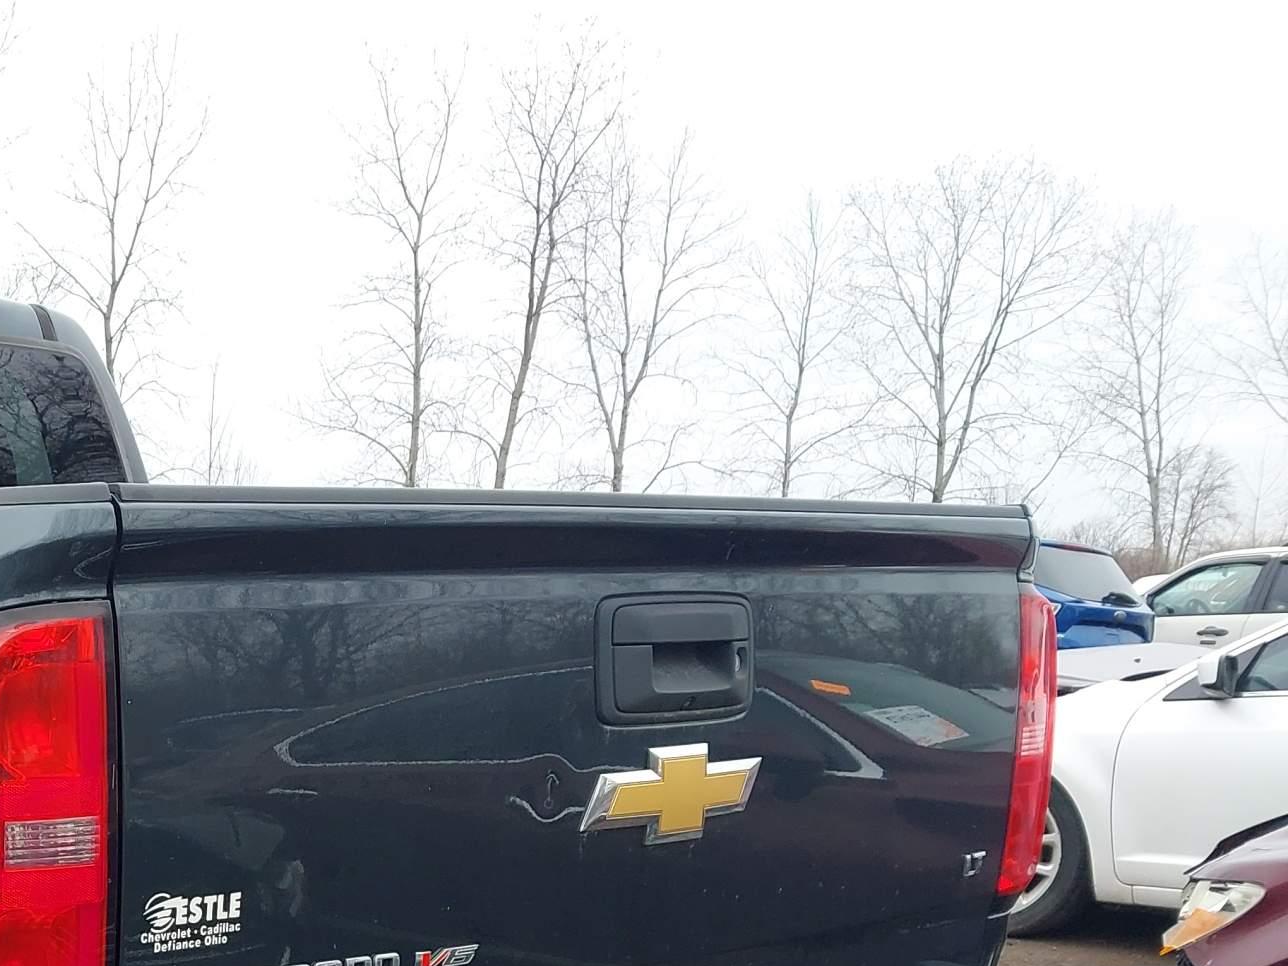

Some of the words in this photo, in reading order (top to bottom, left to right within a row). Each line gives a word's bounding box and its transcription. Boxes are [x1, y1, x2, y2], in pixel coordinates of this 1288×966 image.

[961, 850, 987, 877] LT
[170, 891, 242, 926] ESTLE
[140, 928, 192, 944] Chevrolet
[200, 922, 241, 936] Cadillac
[153, 939, 201, 953] Defiance
[204, 934, 228, 946] Ohio
